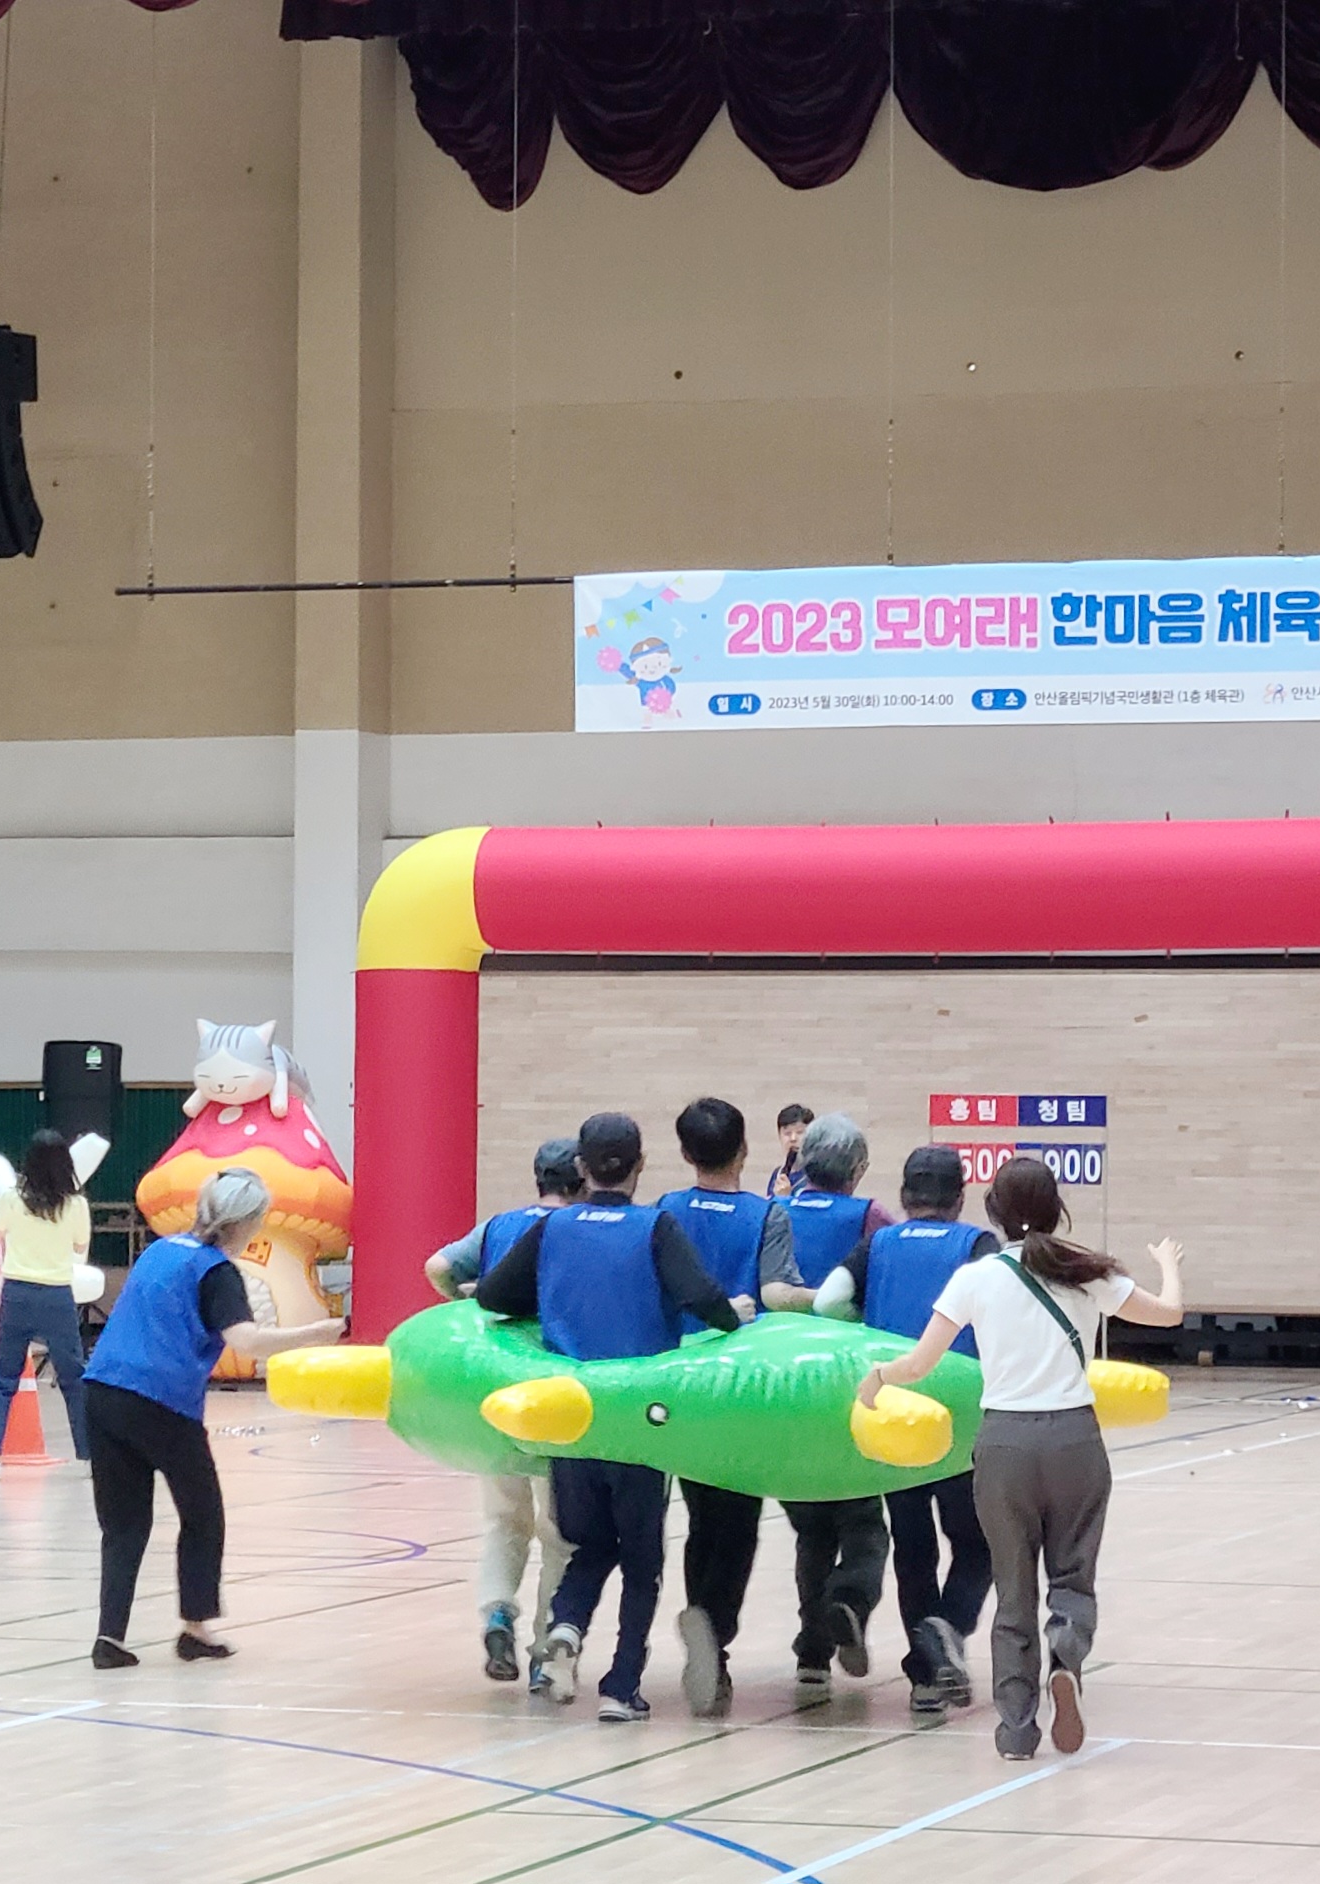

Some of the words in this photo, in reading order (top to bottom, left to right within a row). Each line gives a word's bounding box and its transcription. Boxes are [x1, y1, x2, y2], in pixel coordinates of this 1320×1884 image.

[726, 601, 863, 655] 2023
[874, 596, 1039, 650] 모여라!
[1050, 591, 1205, 646] 한마음
[768, 696, 810, 710] 2023년
[812, 695, 832, 710] 5월
[834, 694, 881, 710] 30일(화)
[883, 694, 954, 707] 10:00-14:00
[1204, 688, 1246, 704] 체육관)
[1044, 1149, 1102, 1183] 900
